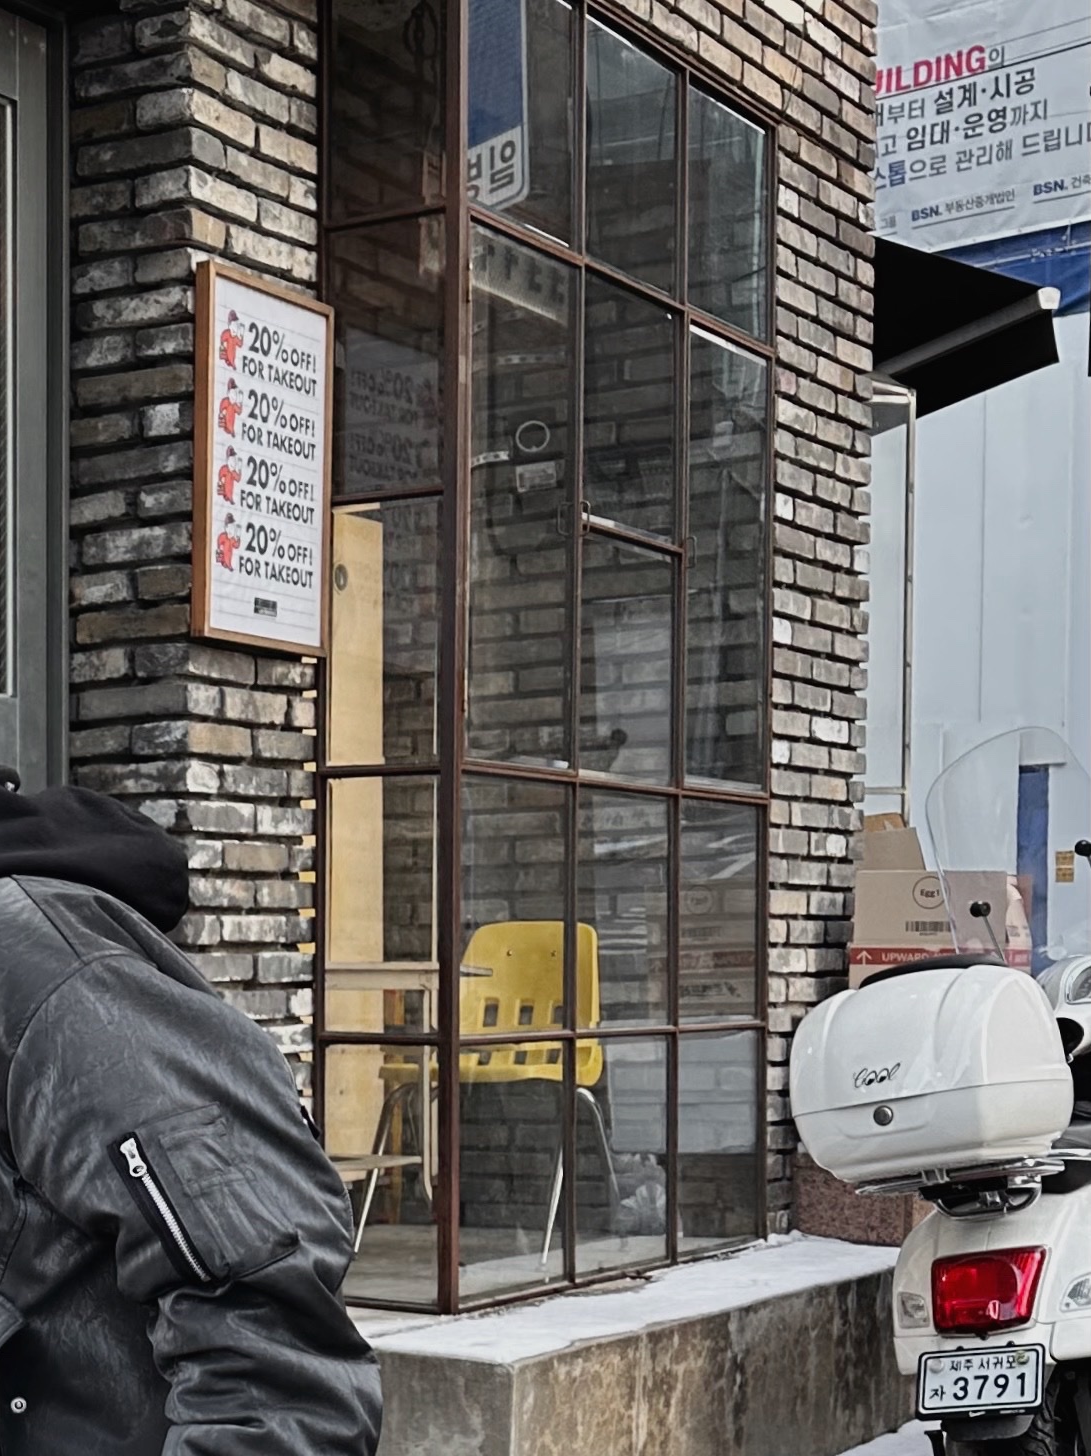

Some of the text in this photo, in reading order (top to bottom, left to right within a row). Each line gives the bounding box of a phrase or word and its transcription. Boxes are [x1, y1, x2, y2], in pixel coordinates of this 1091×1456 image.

[934, 67, 1035, 115] 설계·시공
[906, 98, 1048, 151] 임대·운영까지
[955, 139, 1013, 172] 관리해
[248, 322, 316, 373] 20% OFF!
[242, 355, 317, 397] FOR TAKEOUT
[248, 389, 315, 438] 20% OFF!
[241, 422, 316, 461] FOR TAKEOUT
[246, 455, 314, 502] 20% OFF!
[240, 489, 315, 525] FOR TAKEOUT
[245, 522, 313, 566] 20% OFF!
[239, 555, 313, 589] FOR TAKEOUT
[950, 1358, 973, 1372] 제주
[929, 1372, 1025, 1401] 자 3791
